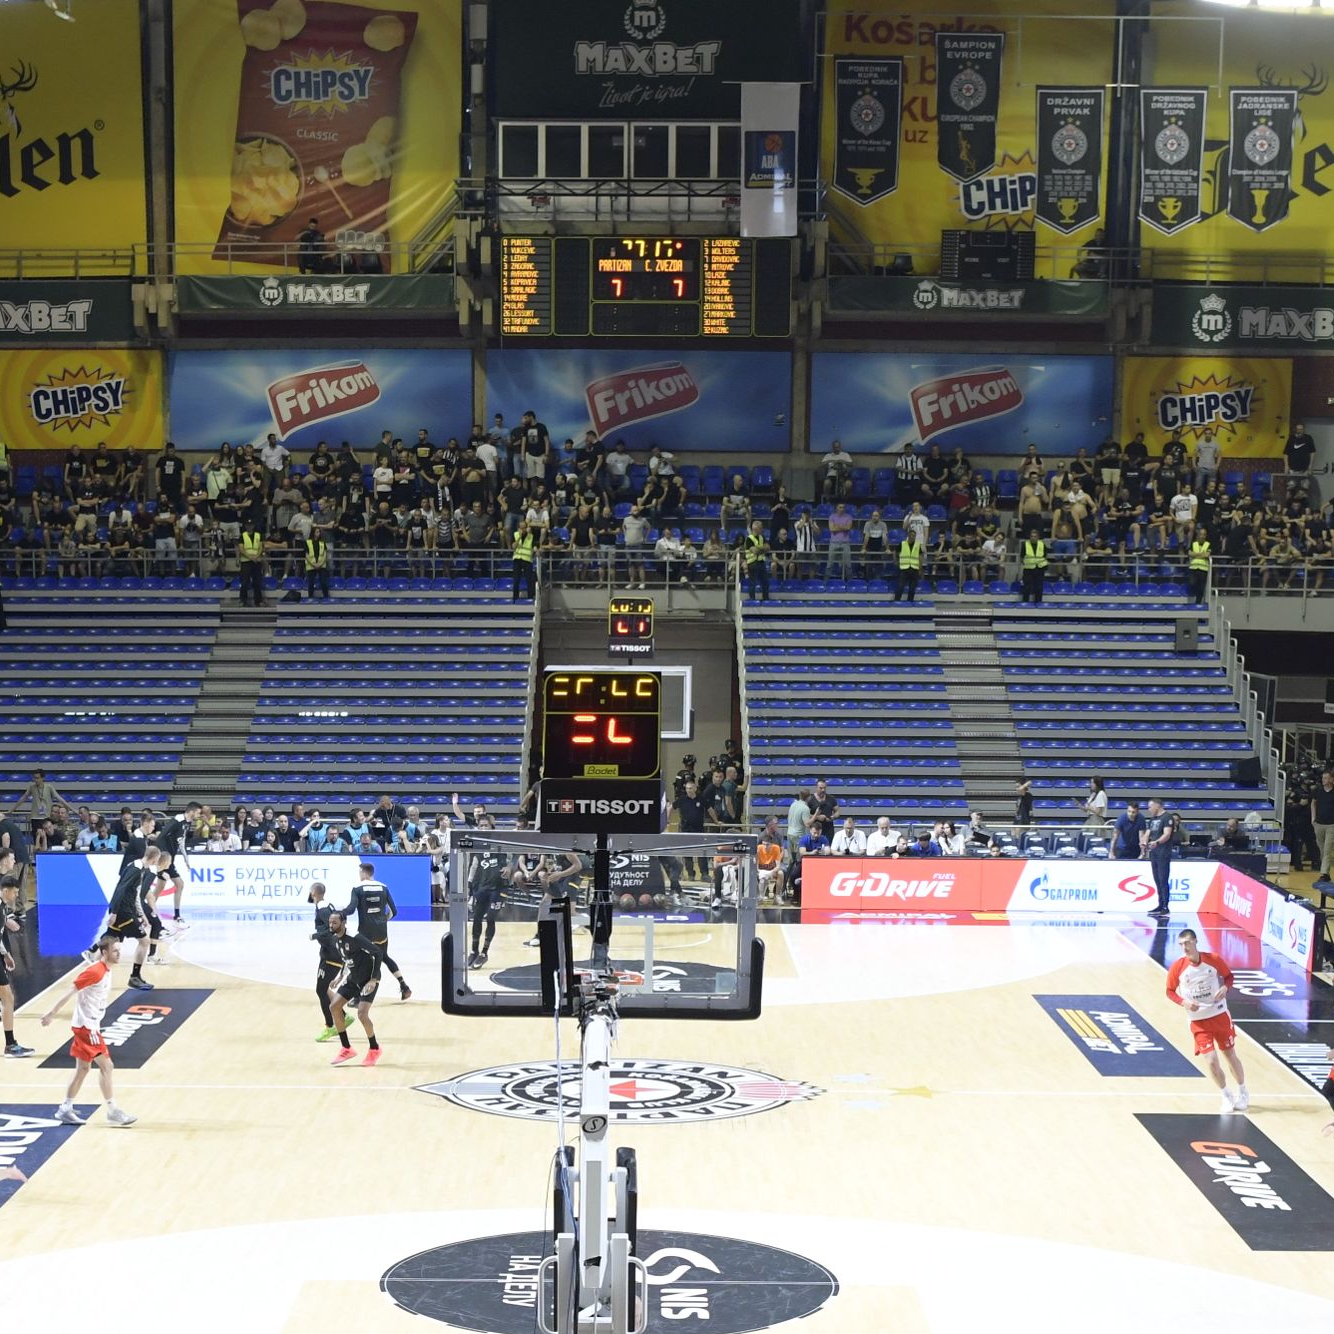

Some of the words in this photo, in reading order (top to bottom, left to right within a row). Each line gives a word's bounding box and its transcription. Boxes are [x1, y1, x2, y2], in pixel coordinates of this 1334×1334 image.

[944, 40, 995, 49] ŠAMPION
[947, 51, 992, 59] EVROPE
[1046, 97, 1095, 105] DRŽAVNI
[297, 129, 338, 141] CLASSIC
[905, 130, 928, 143] uz
[599, 260, 632, 271] PARTIZAN
[612, 280, 622, 297] 7
[673, 280, 683, 297] 7
[276, 362, 376, 425] Frikom
[595, 364, 693, 424] Frikom
[917, 374, 1017, 427] Frikom
[576, 800, 653, 814] TISSOT
[191, 868, 224, 882] NIS
[236, 868, 329, 882] БУДУЋНОСТ
[236, 885, 256, 896] НА
[262, 885, 303, 899] ДЕЛУ
[1050, 889, 1098, 901] GAZPROM
[660, 1288, 710, 1320] NIS
